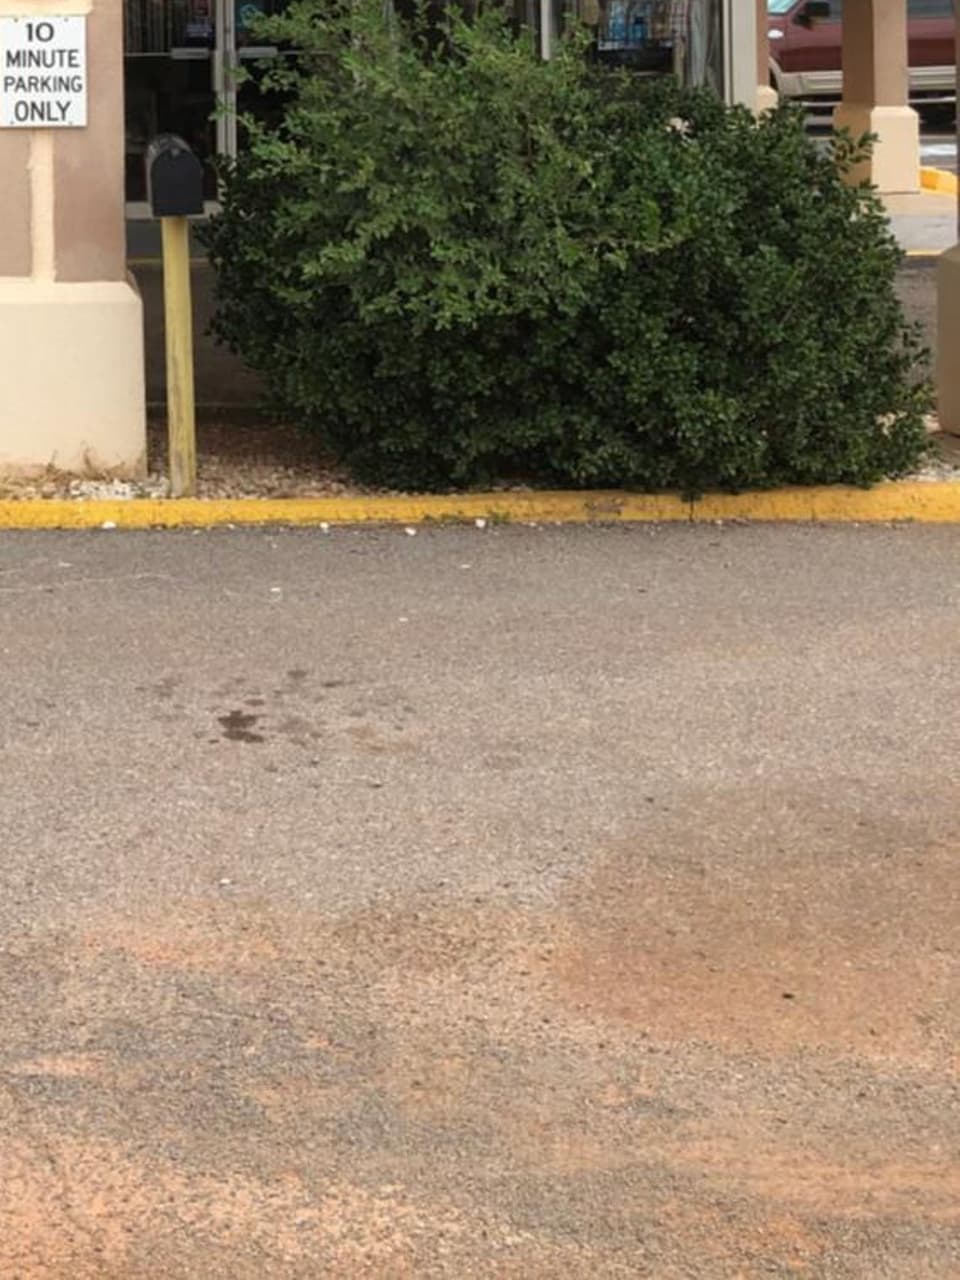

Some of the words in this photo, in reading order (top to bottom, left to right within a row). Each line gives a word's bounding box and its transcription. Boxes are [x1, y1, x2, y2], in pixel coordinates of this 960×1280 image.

[25, 22, 55, 43] 10
[5, 49, 81, 69] MINUTE
[3, 75, 83, 94] PARKING
[14, 100, 72, 122] ONLY
